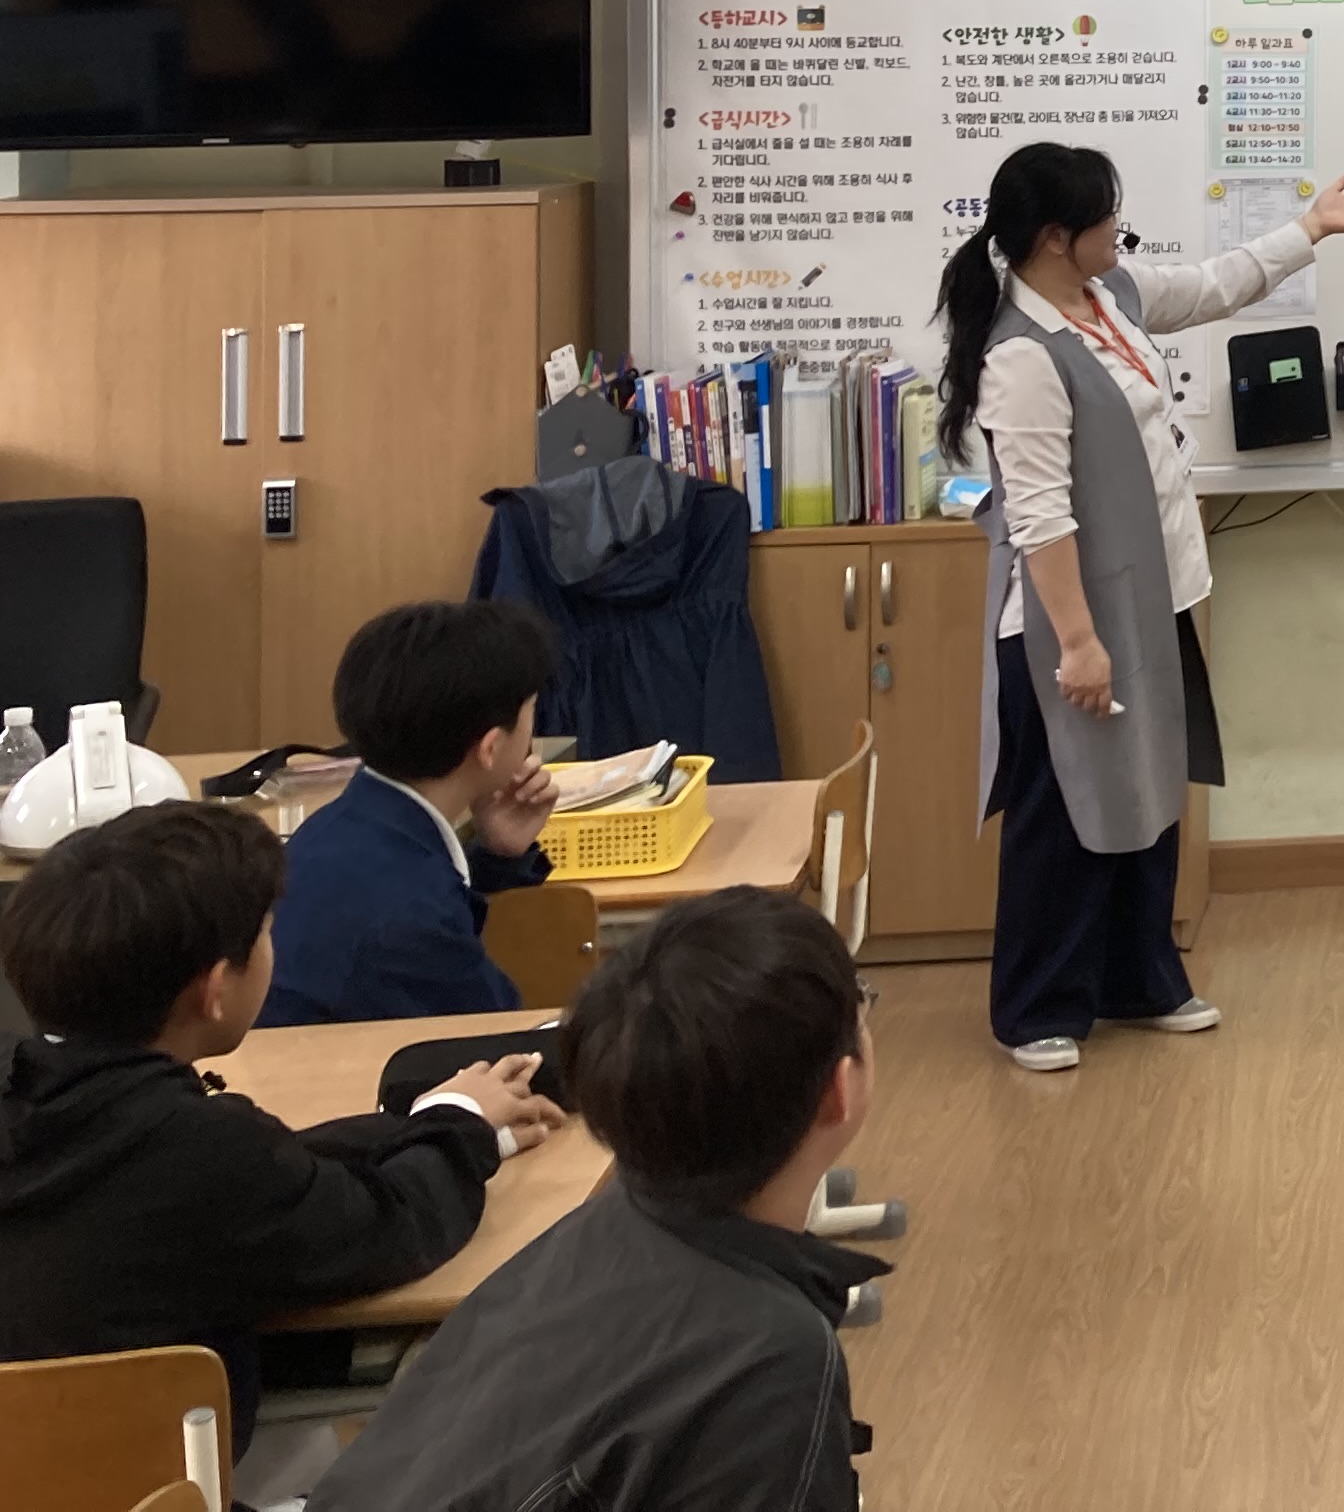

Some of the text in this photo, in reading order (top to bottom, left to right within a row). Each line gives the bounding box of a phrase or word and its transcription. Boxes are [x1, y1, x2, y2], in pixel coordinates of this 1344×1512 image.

[699, 10, 788, 29] <등하교시>
[942, 26, 1065, 46] <안전한 생활>
[733, 37, 842, 49] 40분부터 9시 사이에
[712, 58, 838, 71] 학교에 바퀴달린
[956, 52, 1128, 66] 복도와 계단에서 오른쪽으로 조용히
[1227, 60, 1246, 68] 1교시
[712, 75, 782, 87] 자전거를 타지
[1064, 73, 1166, 86] 올라가거나 매달리지
[955, 91, 1003, 103] 않습니다.
[699, 110, 792, 130] <급식시간>
[955, 109, 1178, 125] 위험한 가져오지
[955, 127, 1003, 139] 않습니다.
[712, 136, 912, 150] 급식실에서 조용히 차례를
[712, 154, 771, 166] 기다립니다.
[775, 173, 898, 187] 시간을 조용히 식사
[712, 192, 745, 204] 자리를
[712, 210, 886, 225] 건강을 편식하지 환경을
[749, 228, 834, 241] 남기지 않습니다.
[712, 297, 767, 310] 수업시간을
[712, 317, 841, 331] 친구와 선생님의 이야기를
[776, 339, 830, 352] 적극적으로
